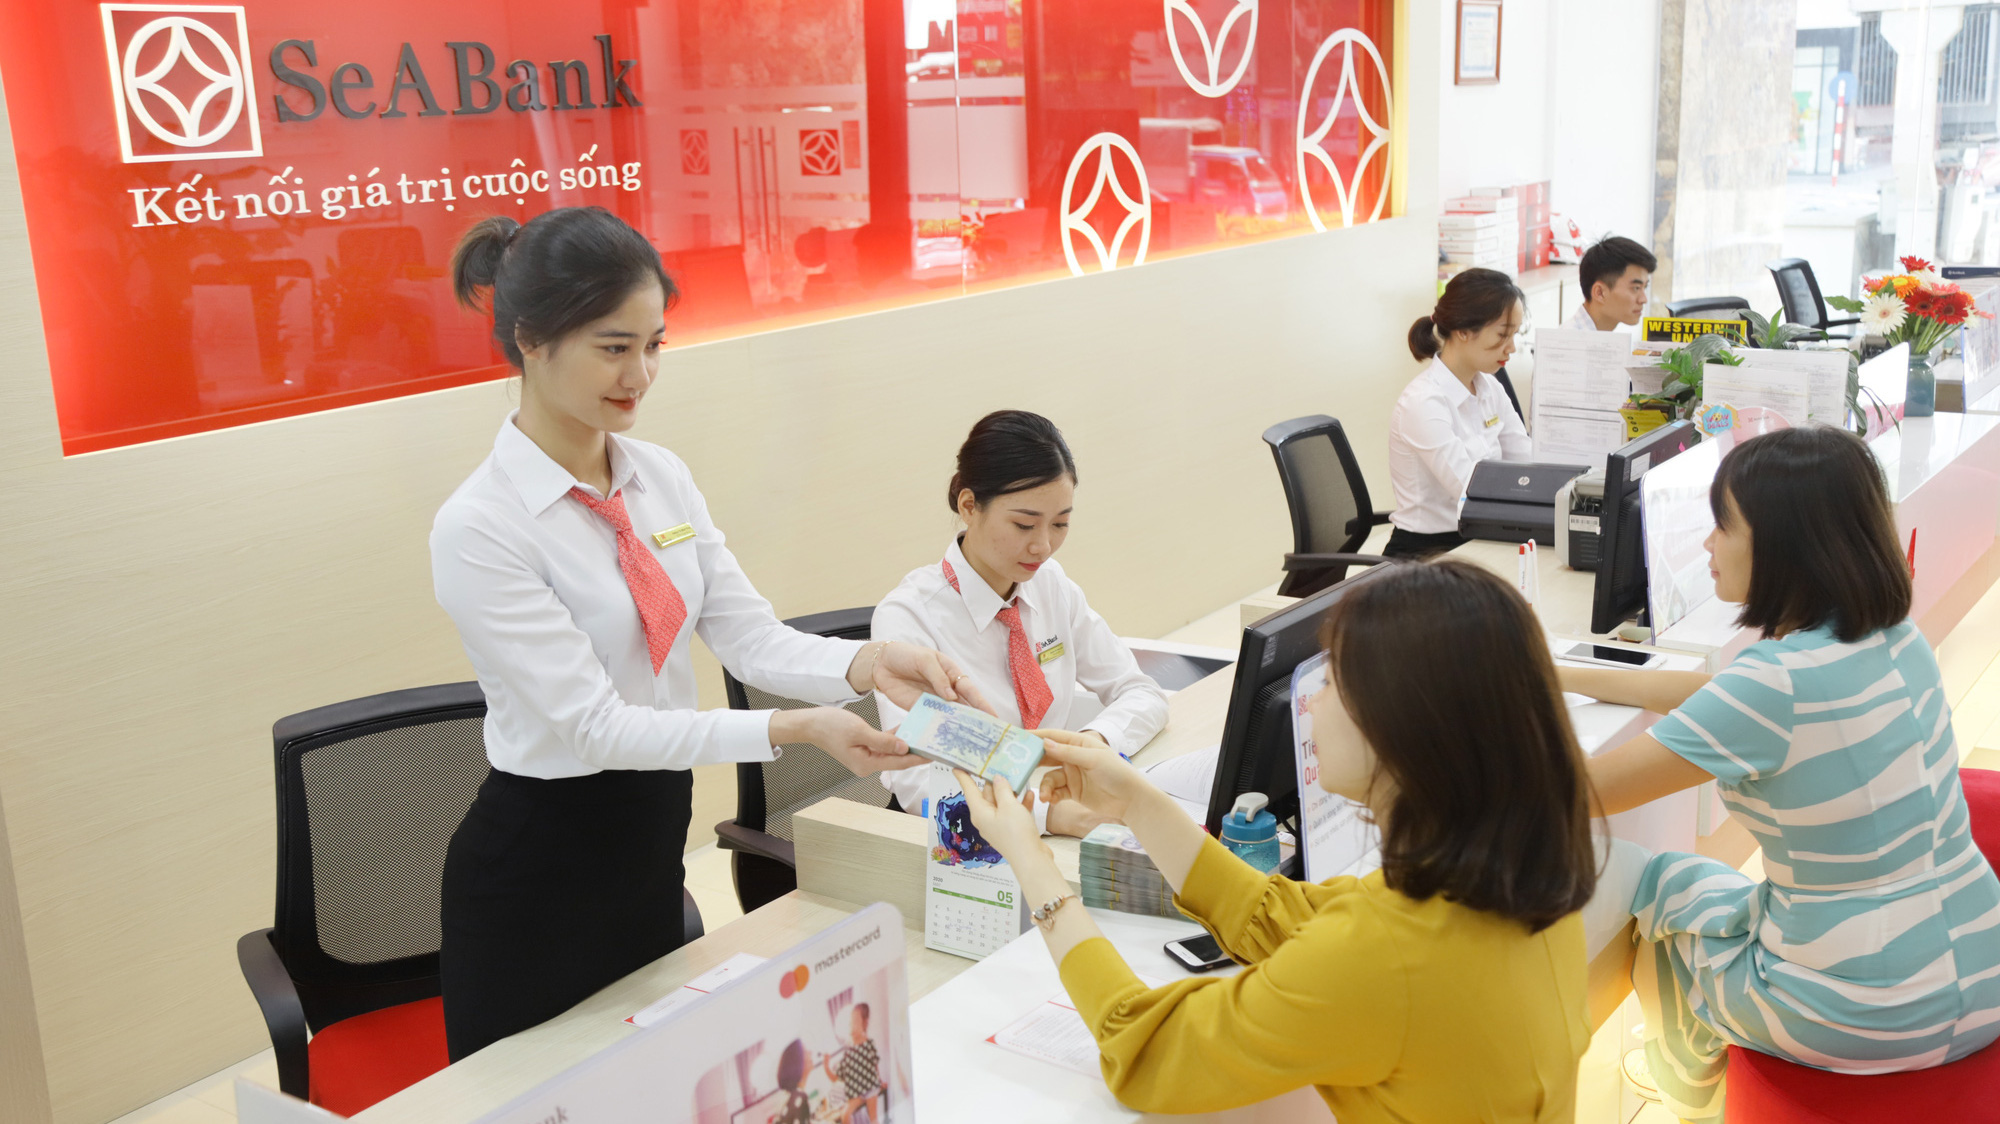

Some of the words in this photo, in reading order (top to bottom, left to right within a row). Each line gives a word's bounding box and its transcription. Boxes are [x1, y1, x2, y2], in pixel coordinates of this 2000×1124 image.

[270, 34, 643, 122] SeABank
[127, 173, 225, 227] Kết
[233, 166, 312, 219] nối
[320, 167, 391, 219] giá
[397, 167, 457, 212] trị
[463, 158, 550, 205] cuộc
[559, 143, 641, 192] sống
[1648, 320, 1725, 334] WESTERN
[997, 890, 1013, 904] 05
[815, 925, 881, 975] mastercard
